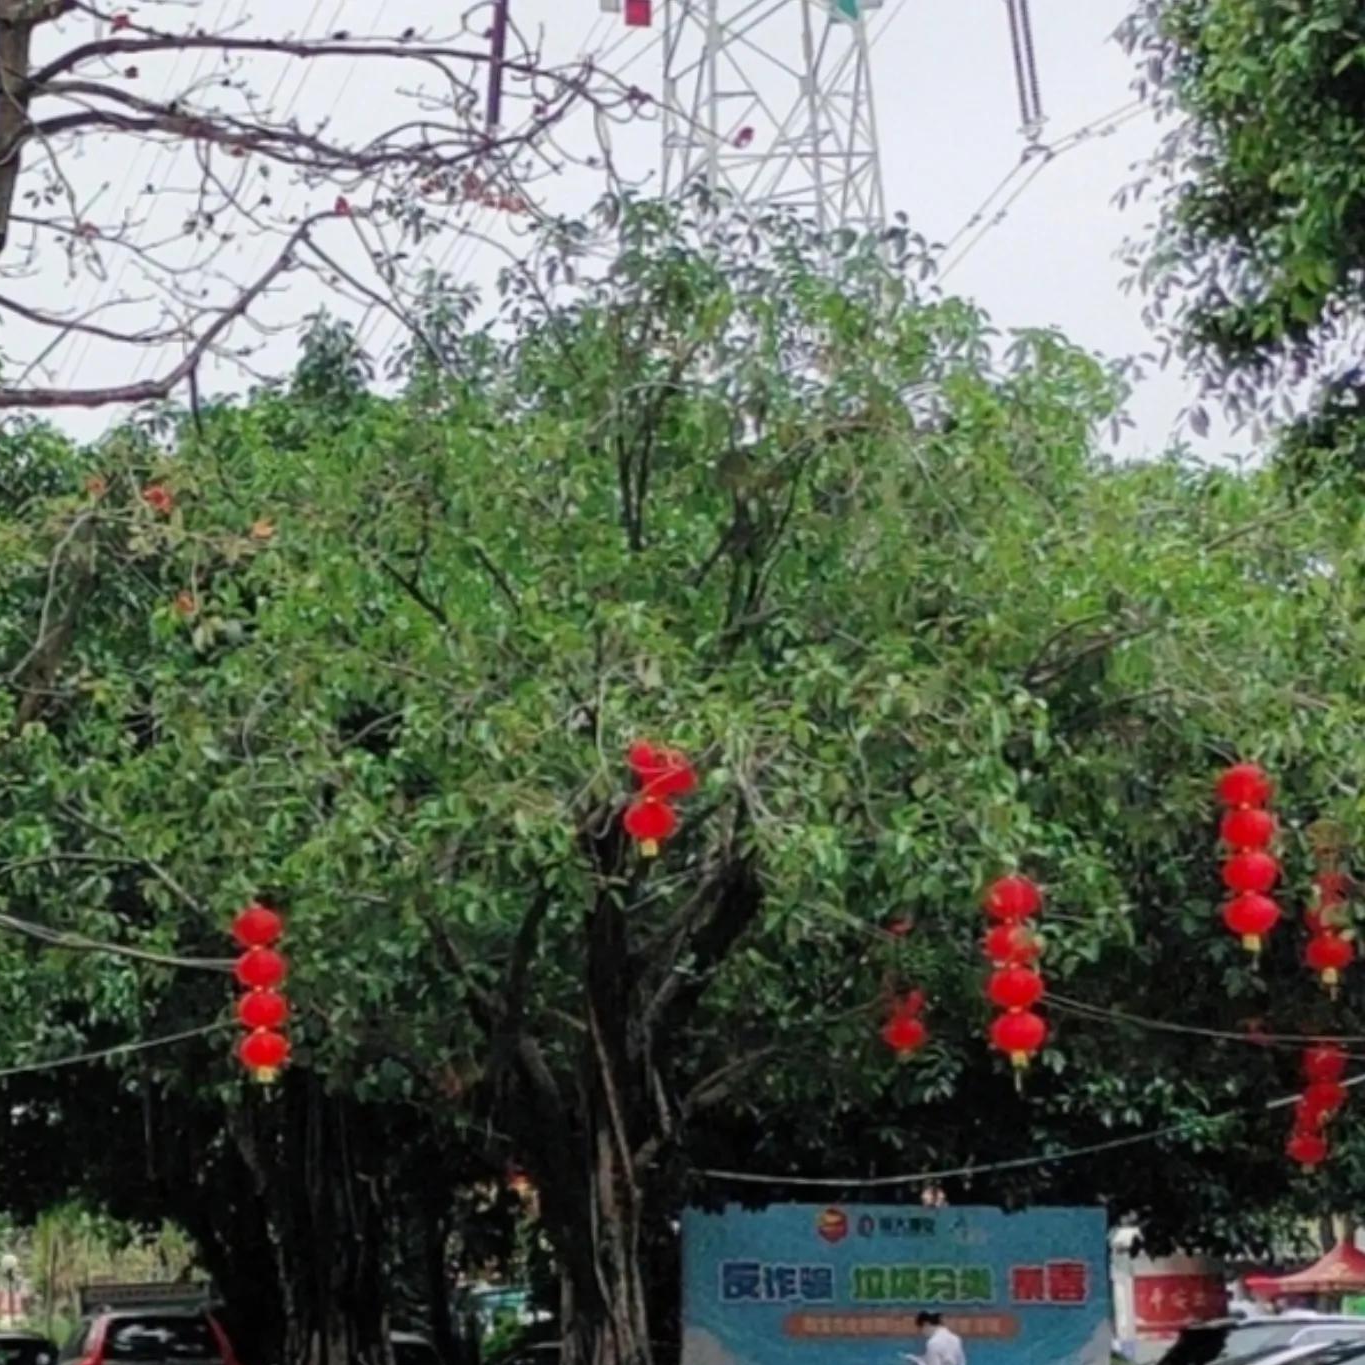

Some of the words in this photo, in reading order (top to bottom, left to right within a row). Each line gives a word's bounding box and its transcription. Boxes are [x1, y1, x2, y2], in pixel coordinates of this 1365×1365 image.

[720, 1261, 834, 1302] 反诈骗
[851, 1262, 995, 1302] 垃圾分类
